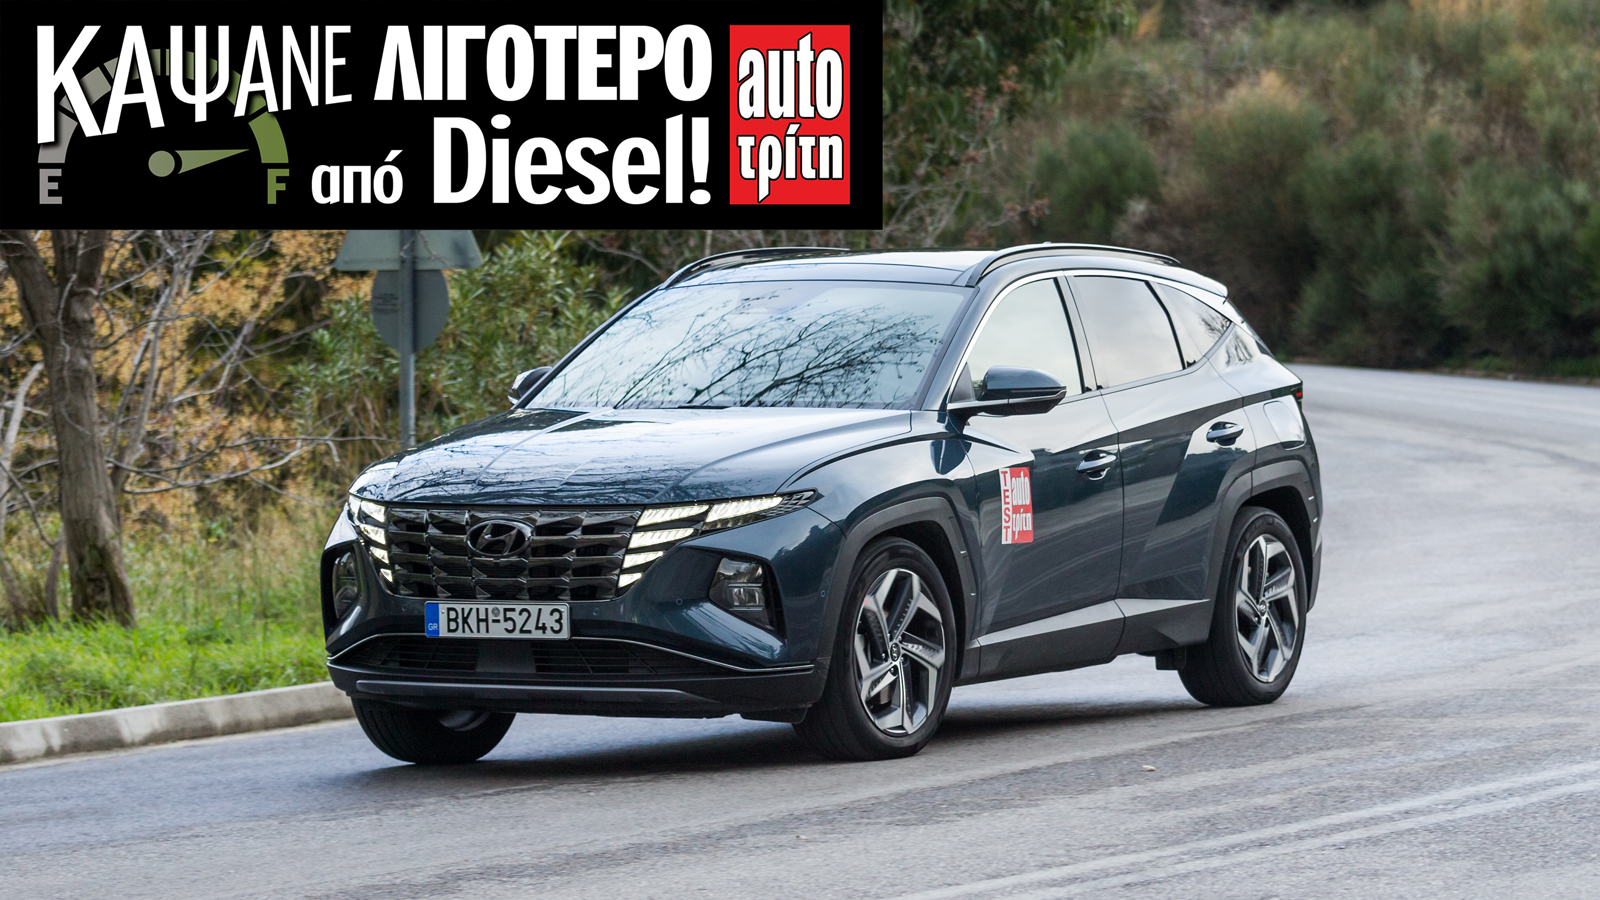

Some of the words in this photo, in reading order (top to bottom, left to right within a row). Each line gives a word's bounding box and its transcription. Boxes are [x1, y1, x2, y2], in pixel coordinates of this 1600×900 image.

[1011, 470, 1031, 506] auto
[1001, 470, 1011, 542] TEST
[428, 623, 438, 631] GR
[446, 607, 564, 635] BKH-5243
